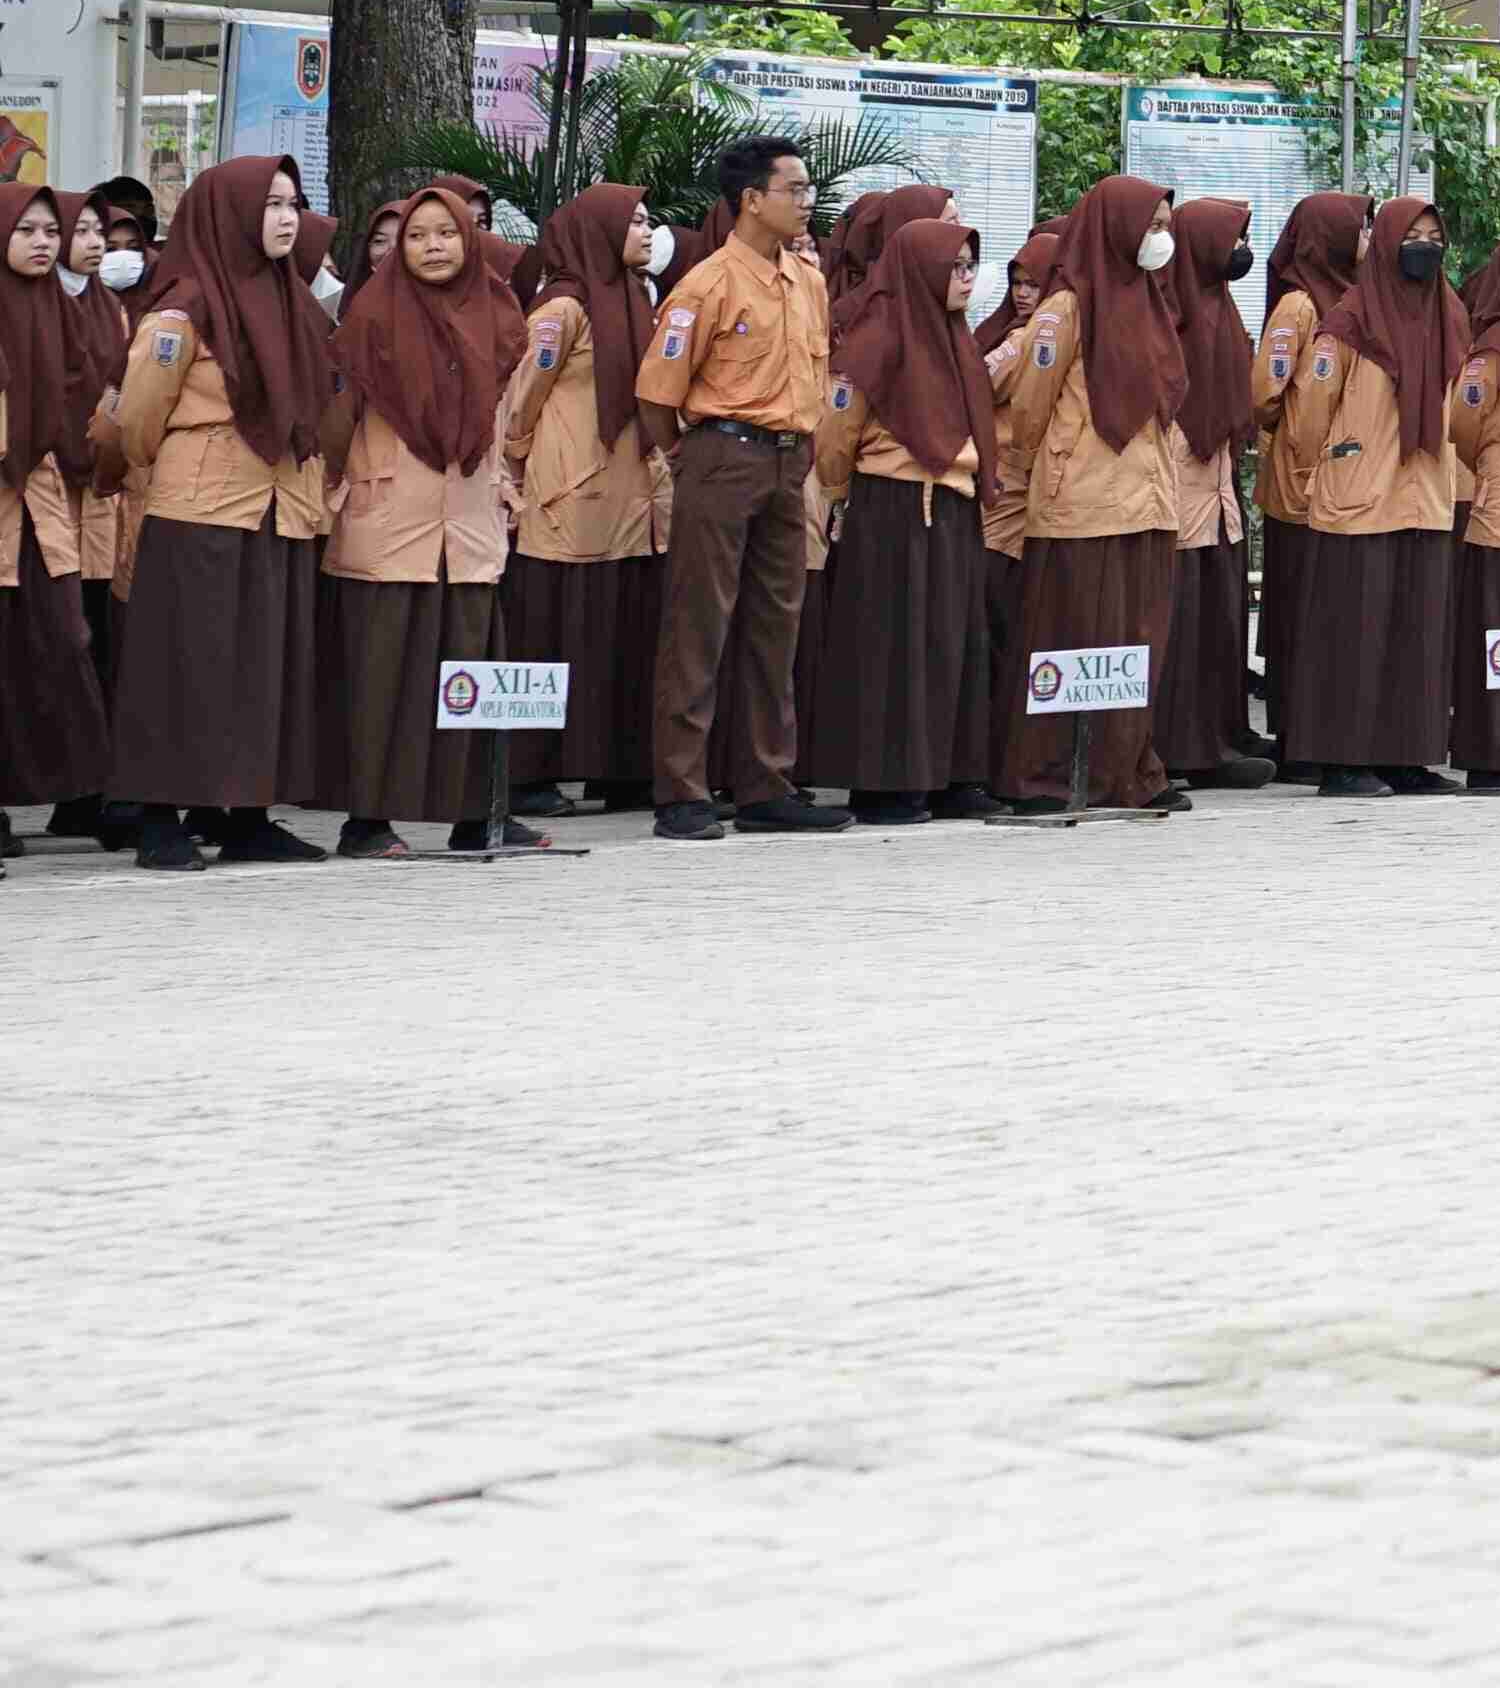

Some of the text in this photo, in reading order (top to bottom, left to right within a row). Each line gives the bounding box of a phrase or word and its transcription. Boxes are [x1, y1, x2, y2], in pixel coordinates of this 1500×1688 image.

[734, 71, 769, 88] DAFTAR
[771, 74, 814, 90] PRESTASI
[815, 78, 846, 92] SISWA
[849, 80, 868, 92] SMK
[870, 81, 901, 94] NEGERI
[911, 84, 973, 99] BANJARMASIN
[975, 89, 1003, 102] TAHUN
[1157, 100, 1188, 113] DAFTAR
[1190, 102, 1230, 114] PRESTASI
[1231, 103, 1259, 115] SISWA
[1261, 104, 1279, 116] SMK
[1074, 653, 1138, 680] XII-C
[490, 668, 558, 694] XII-A
[1064, 681, 1145, 703] AKUNTANSI
